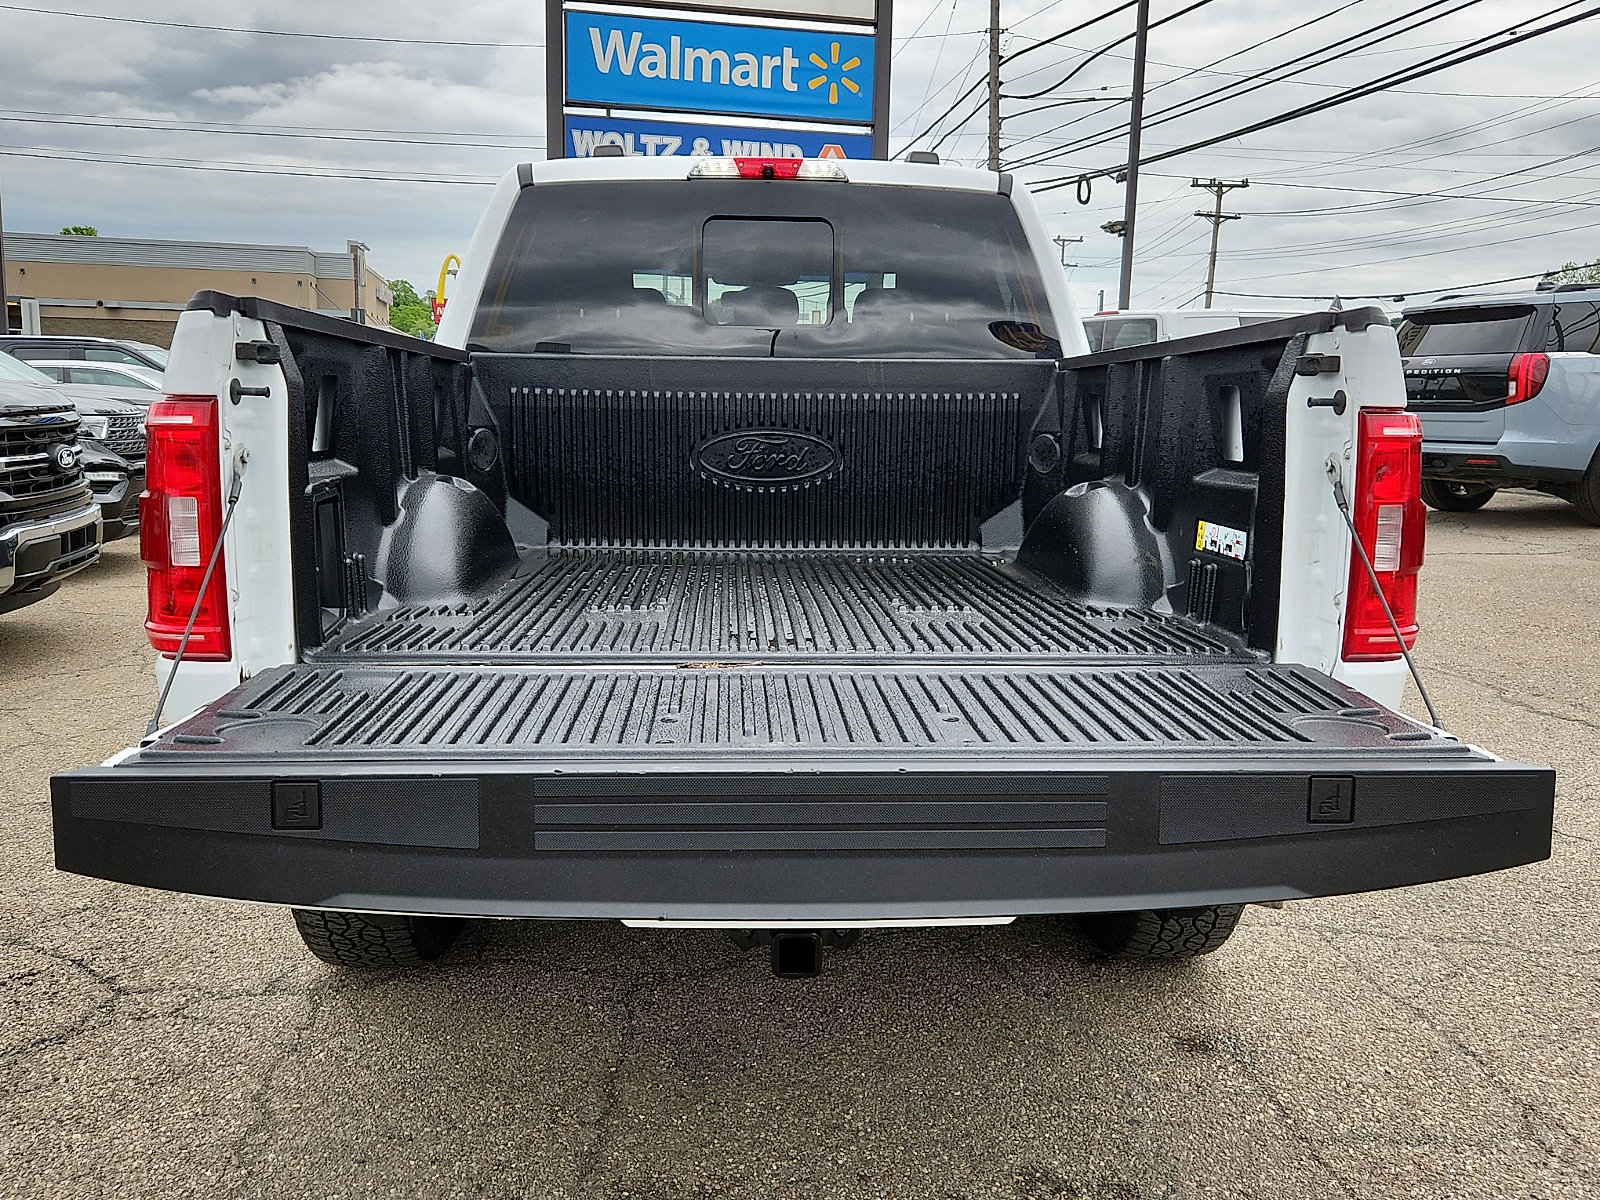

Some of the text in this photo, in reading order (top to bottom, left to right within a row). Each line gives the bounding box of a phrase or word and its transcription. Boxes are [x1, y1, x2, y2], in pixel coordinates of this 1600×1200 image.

[588, 27, 799, 92] Walmart
[571, 129, 804, 159] WOLTZ & WIND
[728, 437, 809, 471] Ford
